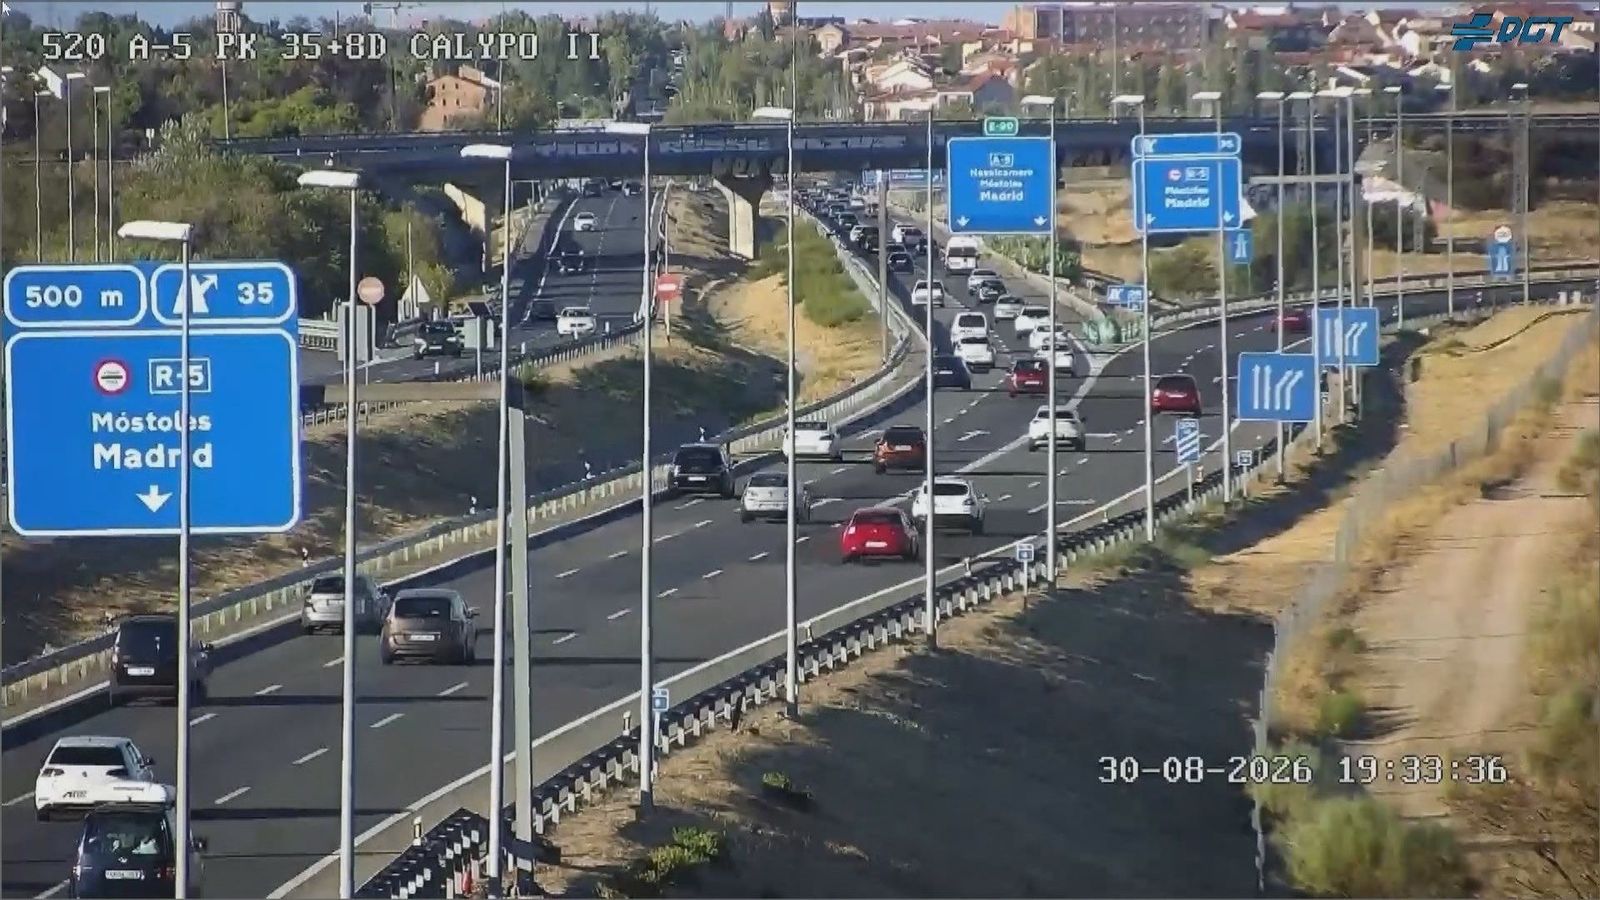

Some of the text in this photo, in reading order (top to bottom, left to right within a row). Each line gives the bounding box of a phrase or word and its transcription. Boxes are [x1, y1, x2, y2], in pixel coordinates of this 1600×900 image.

[988, 121, 1014, 132] E-90
[980, 190, 1024, 201] Madrid
[25, 285, 123, 308] 500 m
[237, 282, 274, 304] 35
[156, 364, 204, 387] R-5
[93, 442, 213, 470] Madrd
